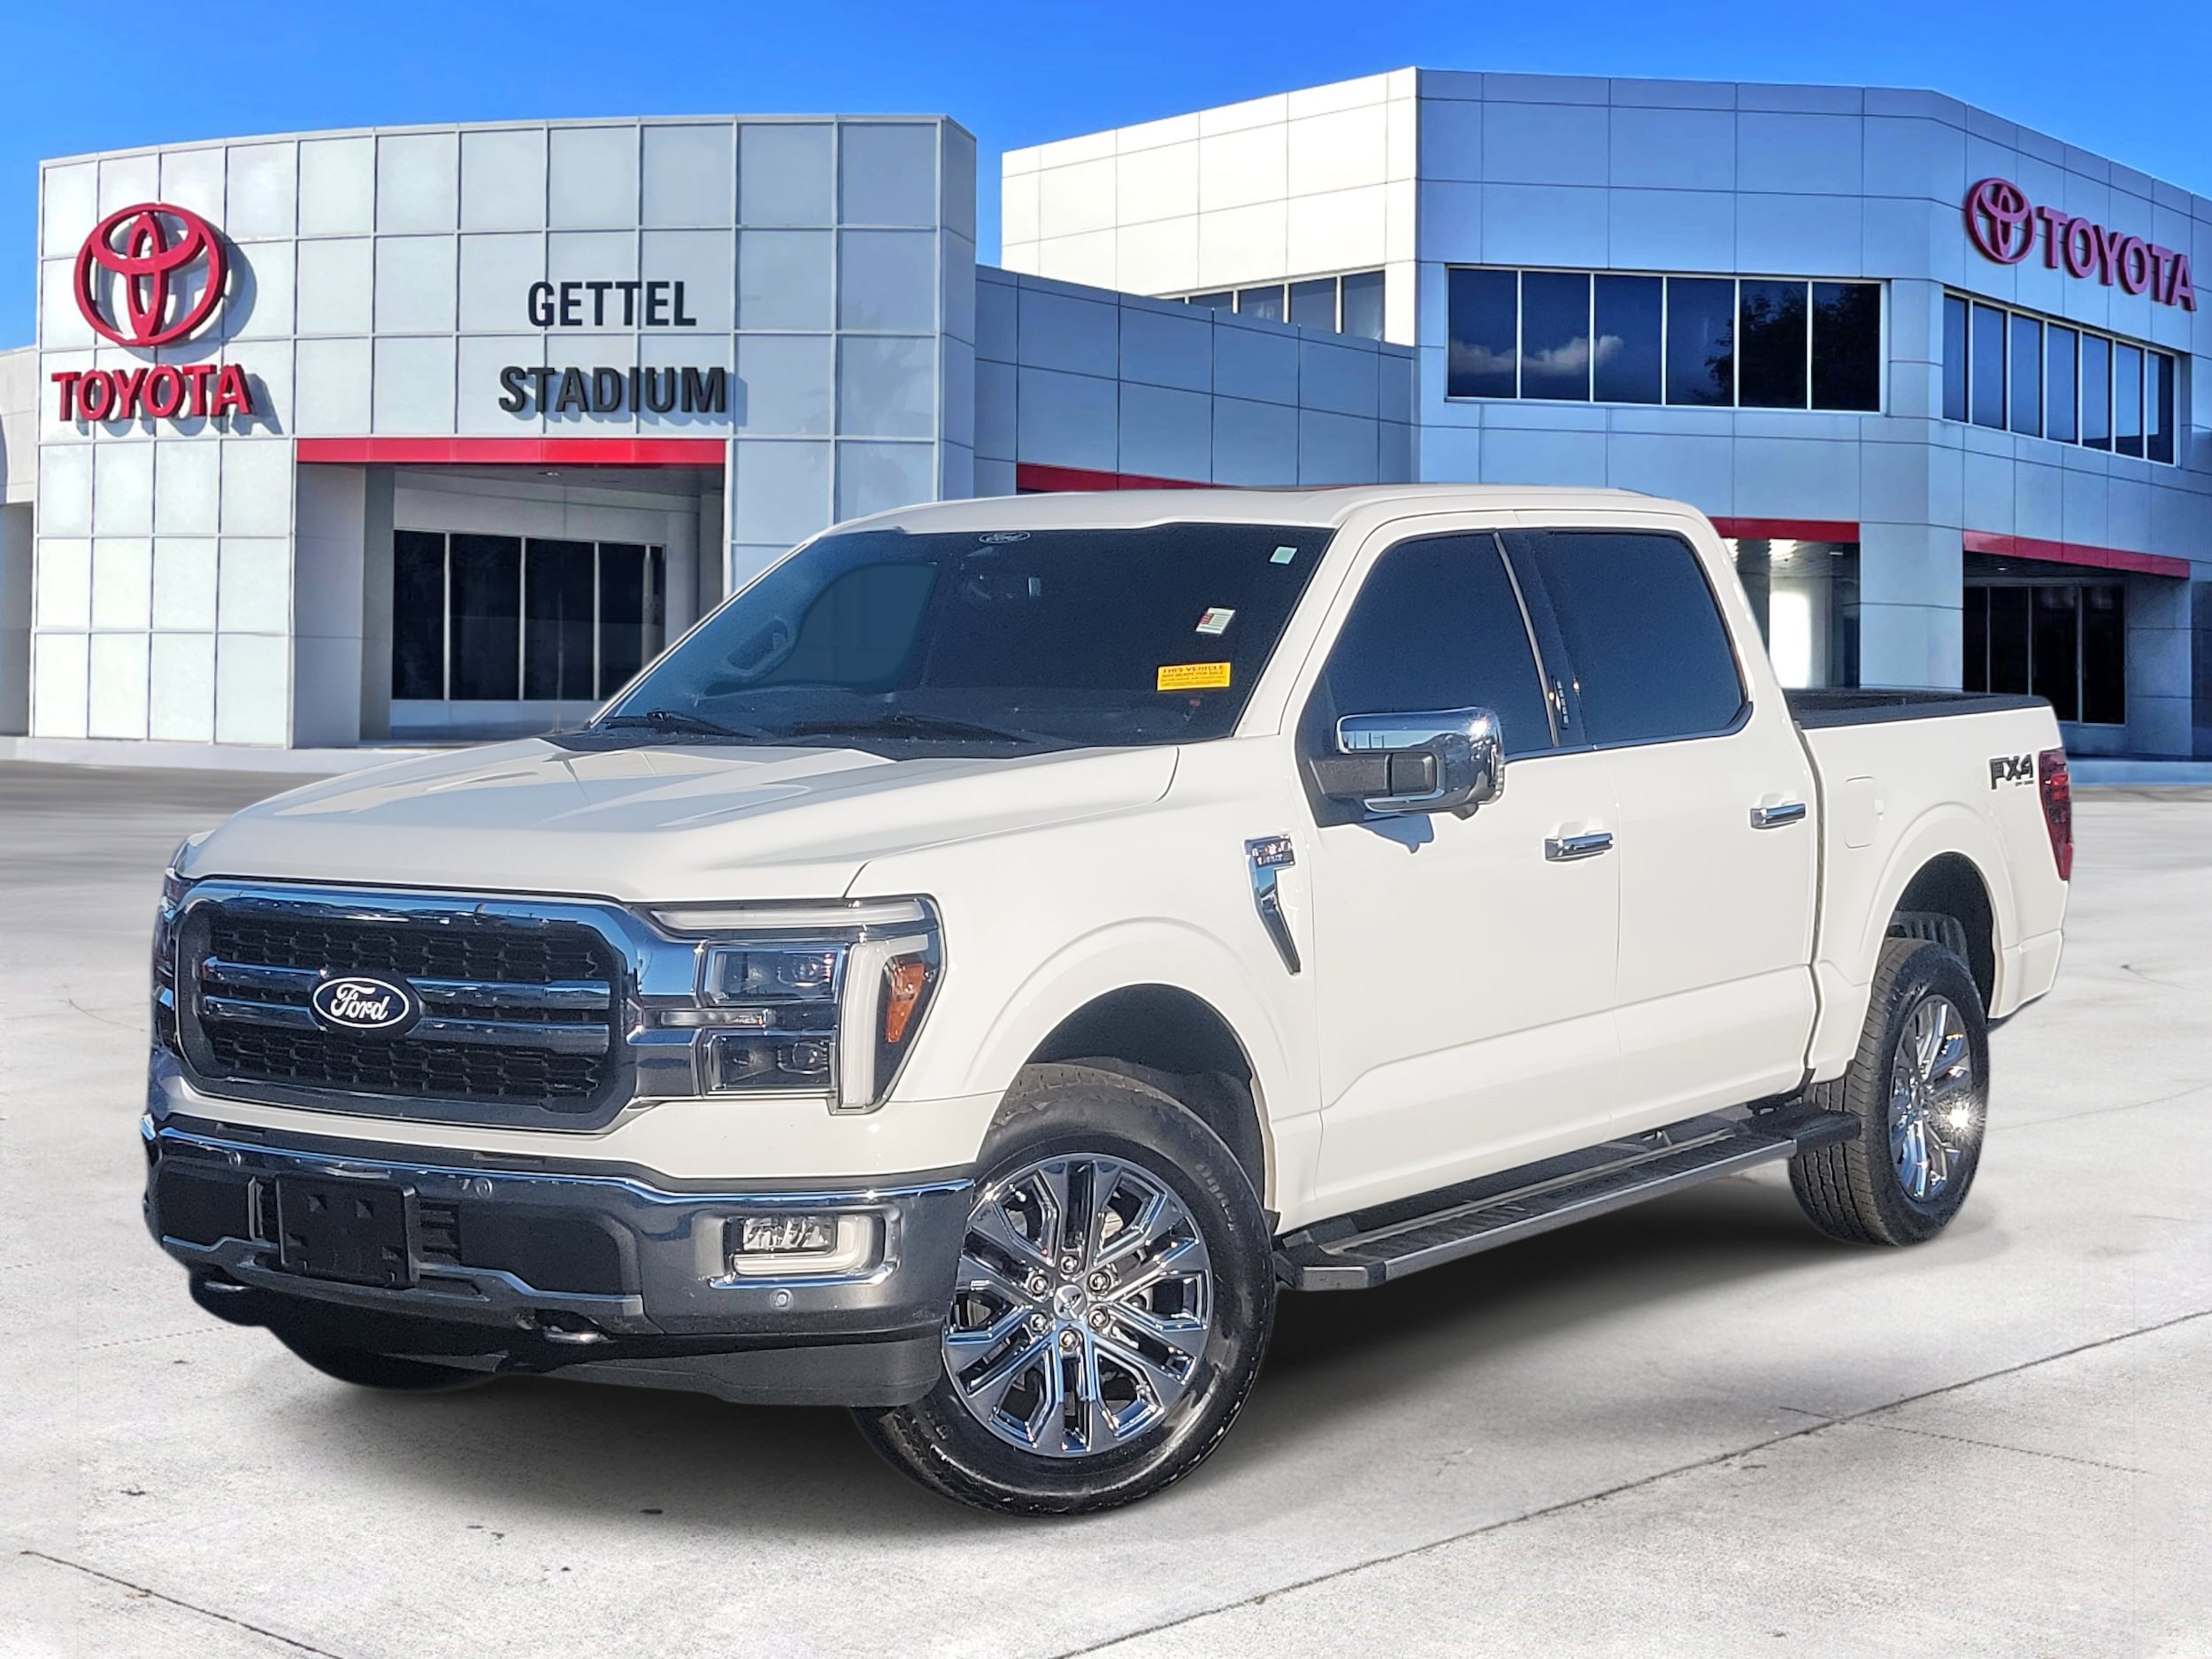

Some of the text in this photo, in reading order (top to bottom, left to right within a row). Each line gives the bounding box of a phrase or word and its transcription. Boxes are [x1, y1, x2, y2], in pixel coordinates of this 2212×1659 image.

[2038, 206, 2197, 311] TOYOTA
[528, 281, 696, 326] GETTEL
[51, 364, 253, 421] TOYOTA
[499, 366, 726, 412] STADIUM
[1989, 754, 2033, 790] FX4
[330, 983, 390, 1021] Ford
